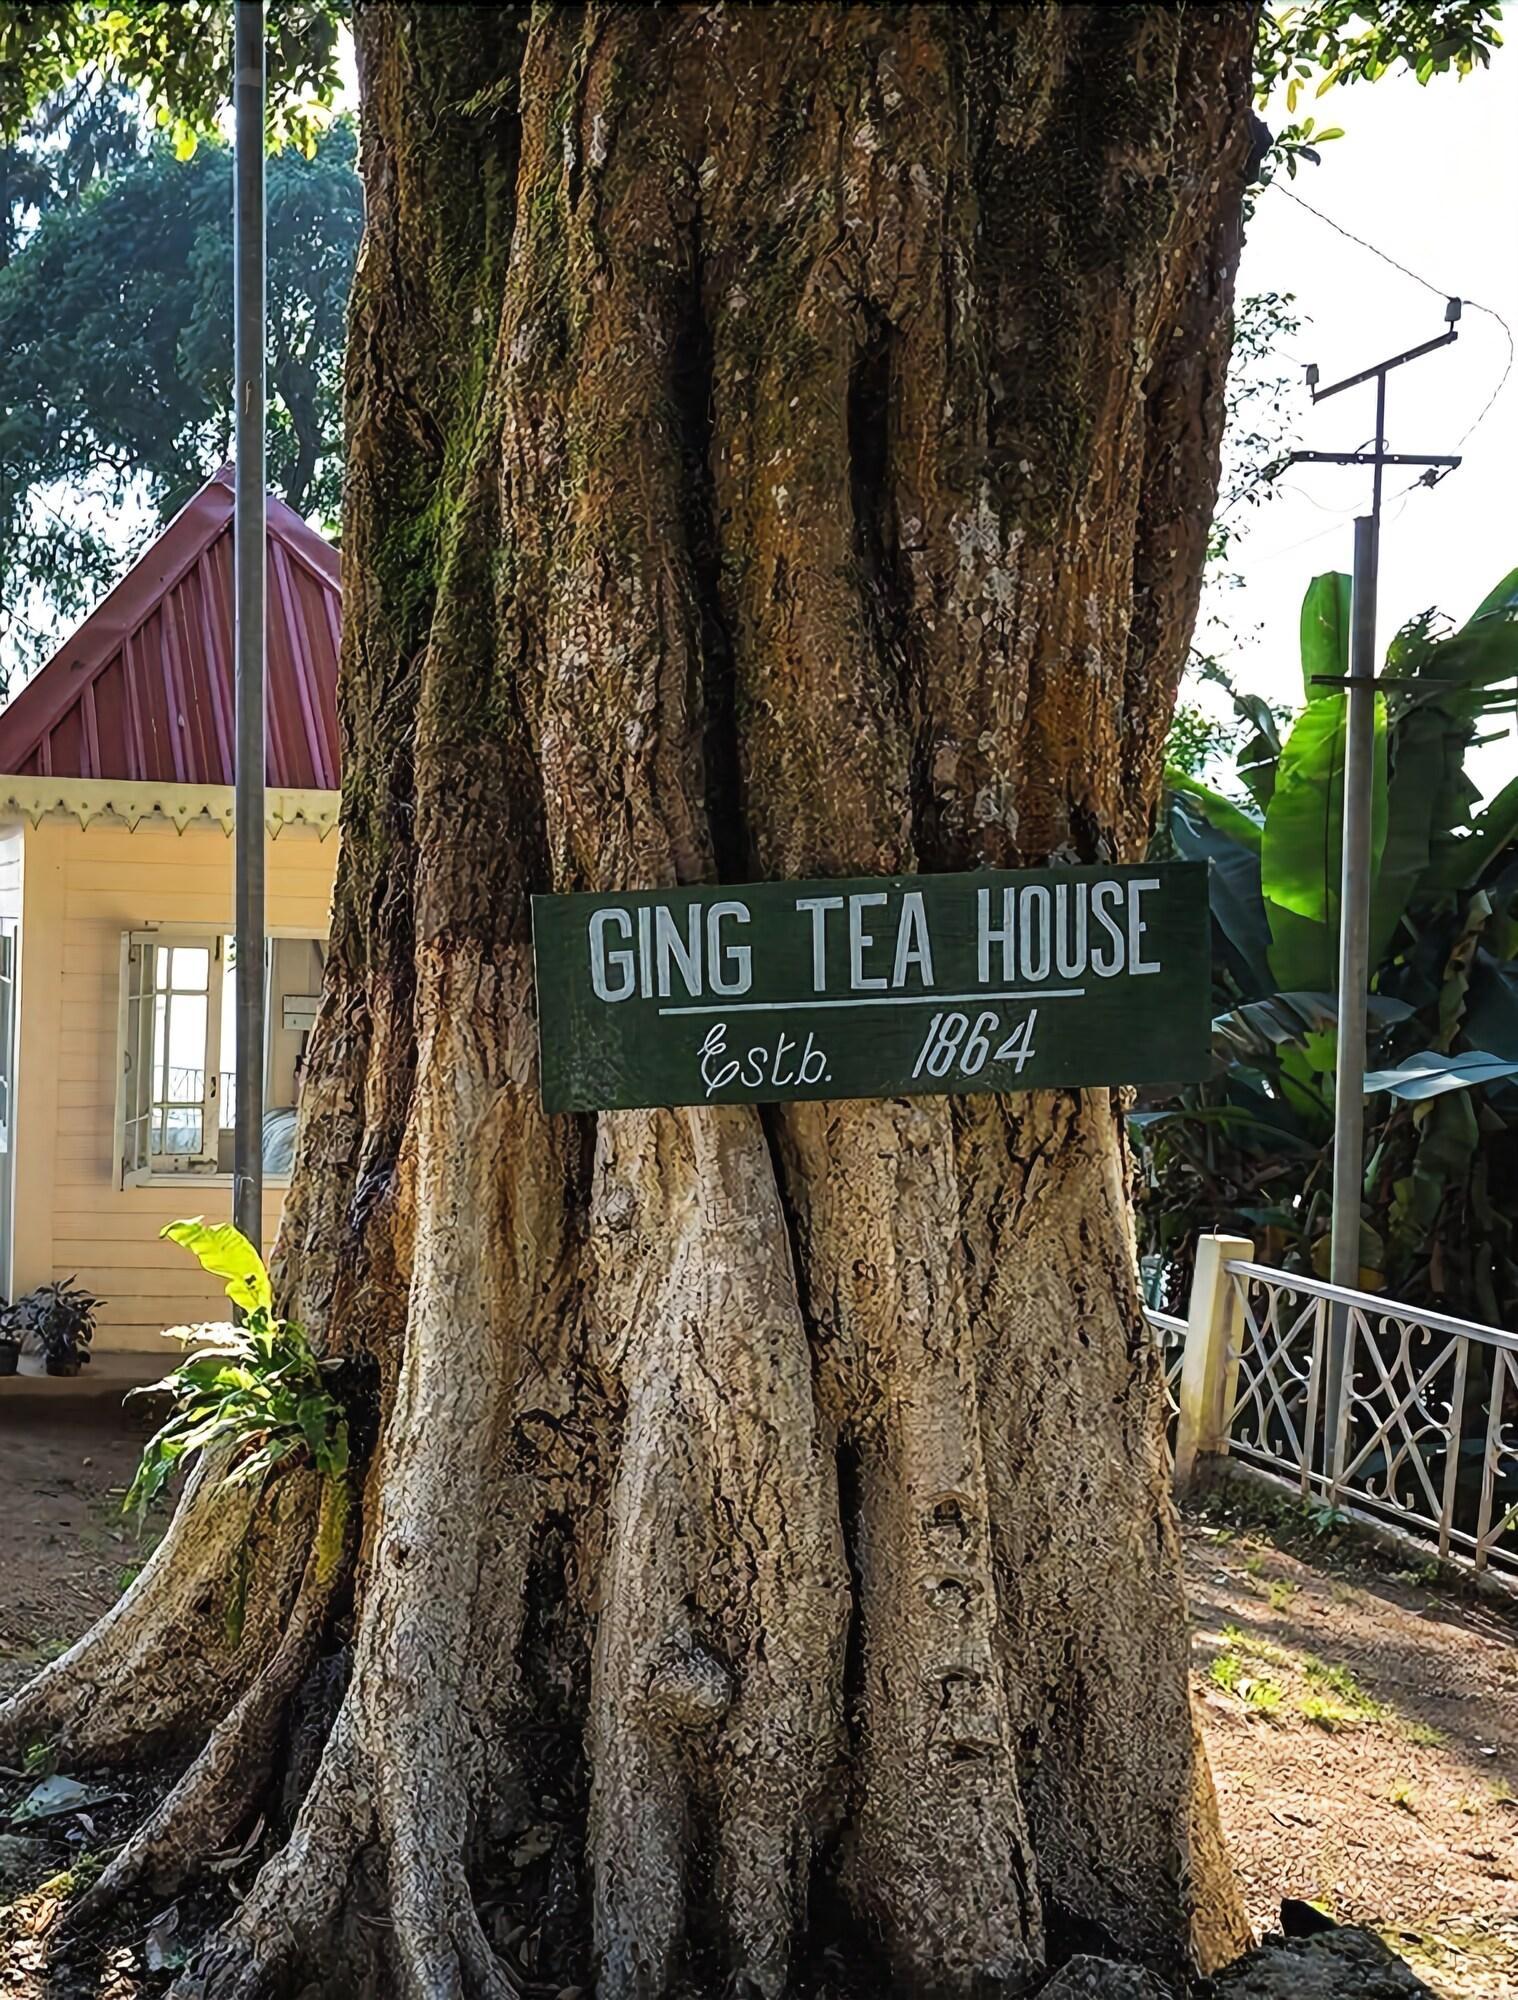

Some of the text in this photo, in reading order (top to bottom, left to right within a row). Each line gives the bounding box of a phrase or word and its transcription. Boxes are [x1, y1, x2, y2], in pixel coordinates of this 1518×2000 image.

[588, 878, 1161, 1002] GING TEA HOUSE
[697, 1008, 1038, 1098] Estb. 1864
